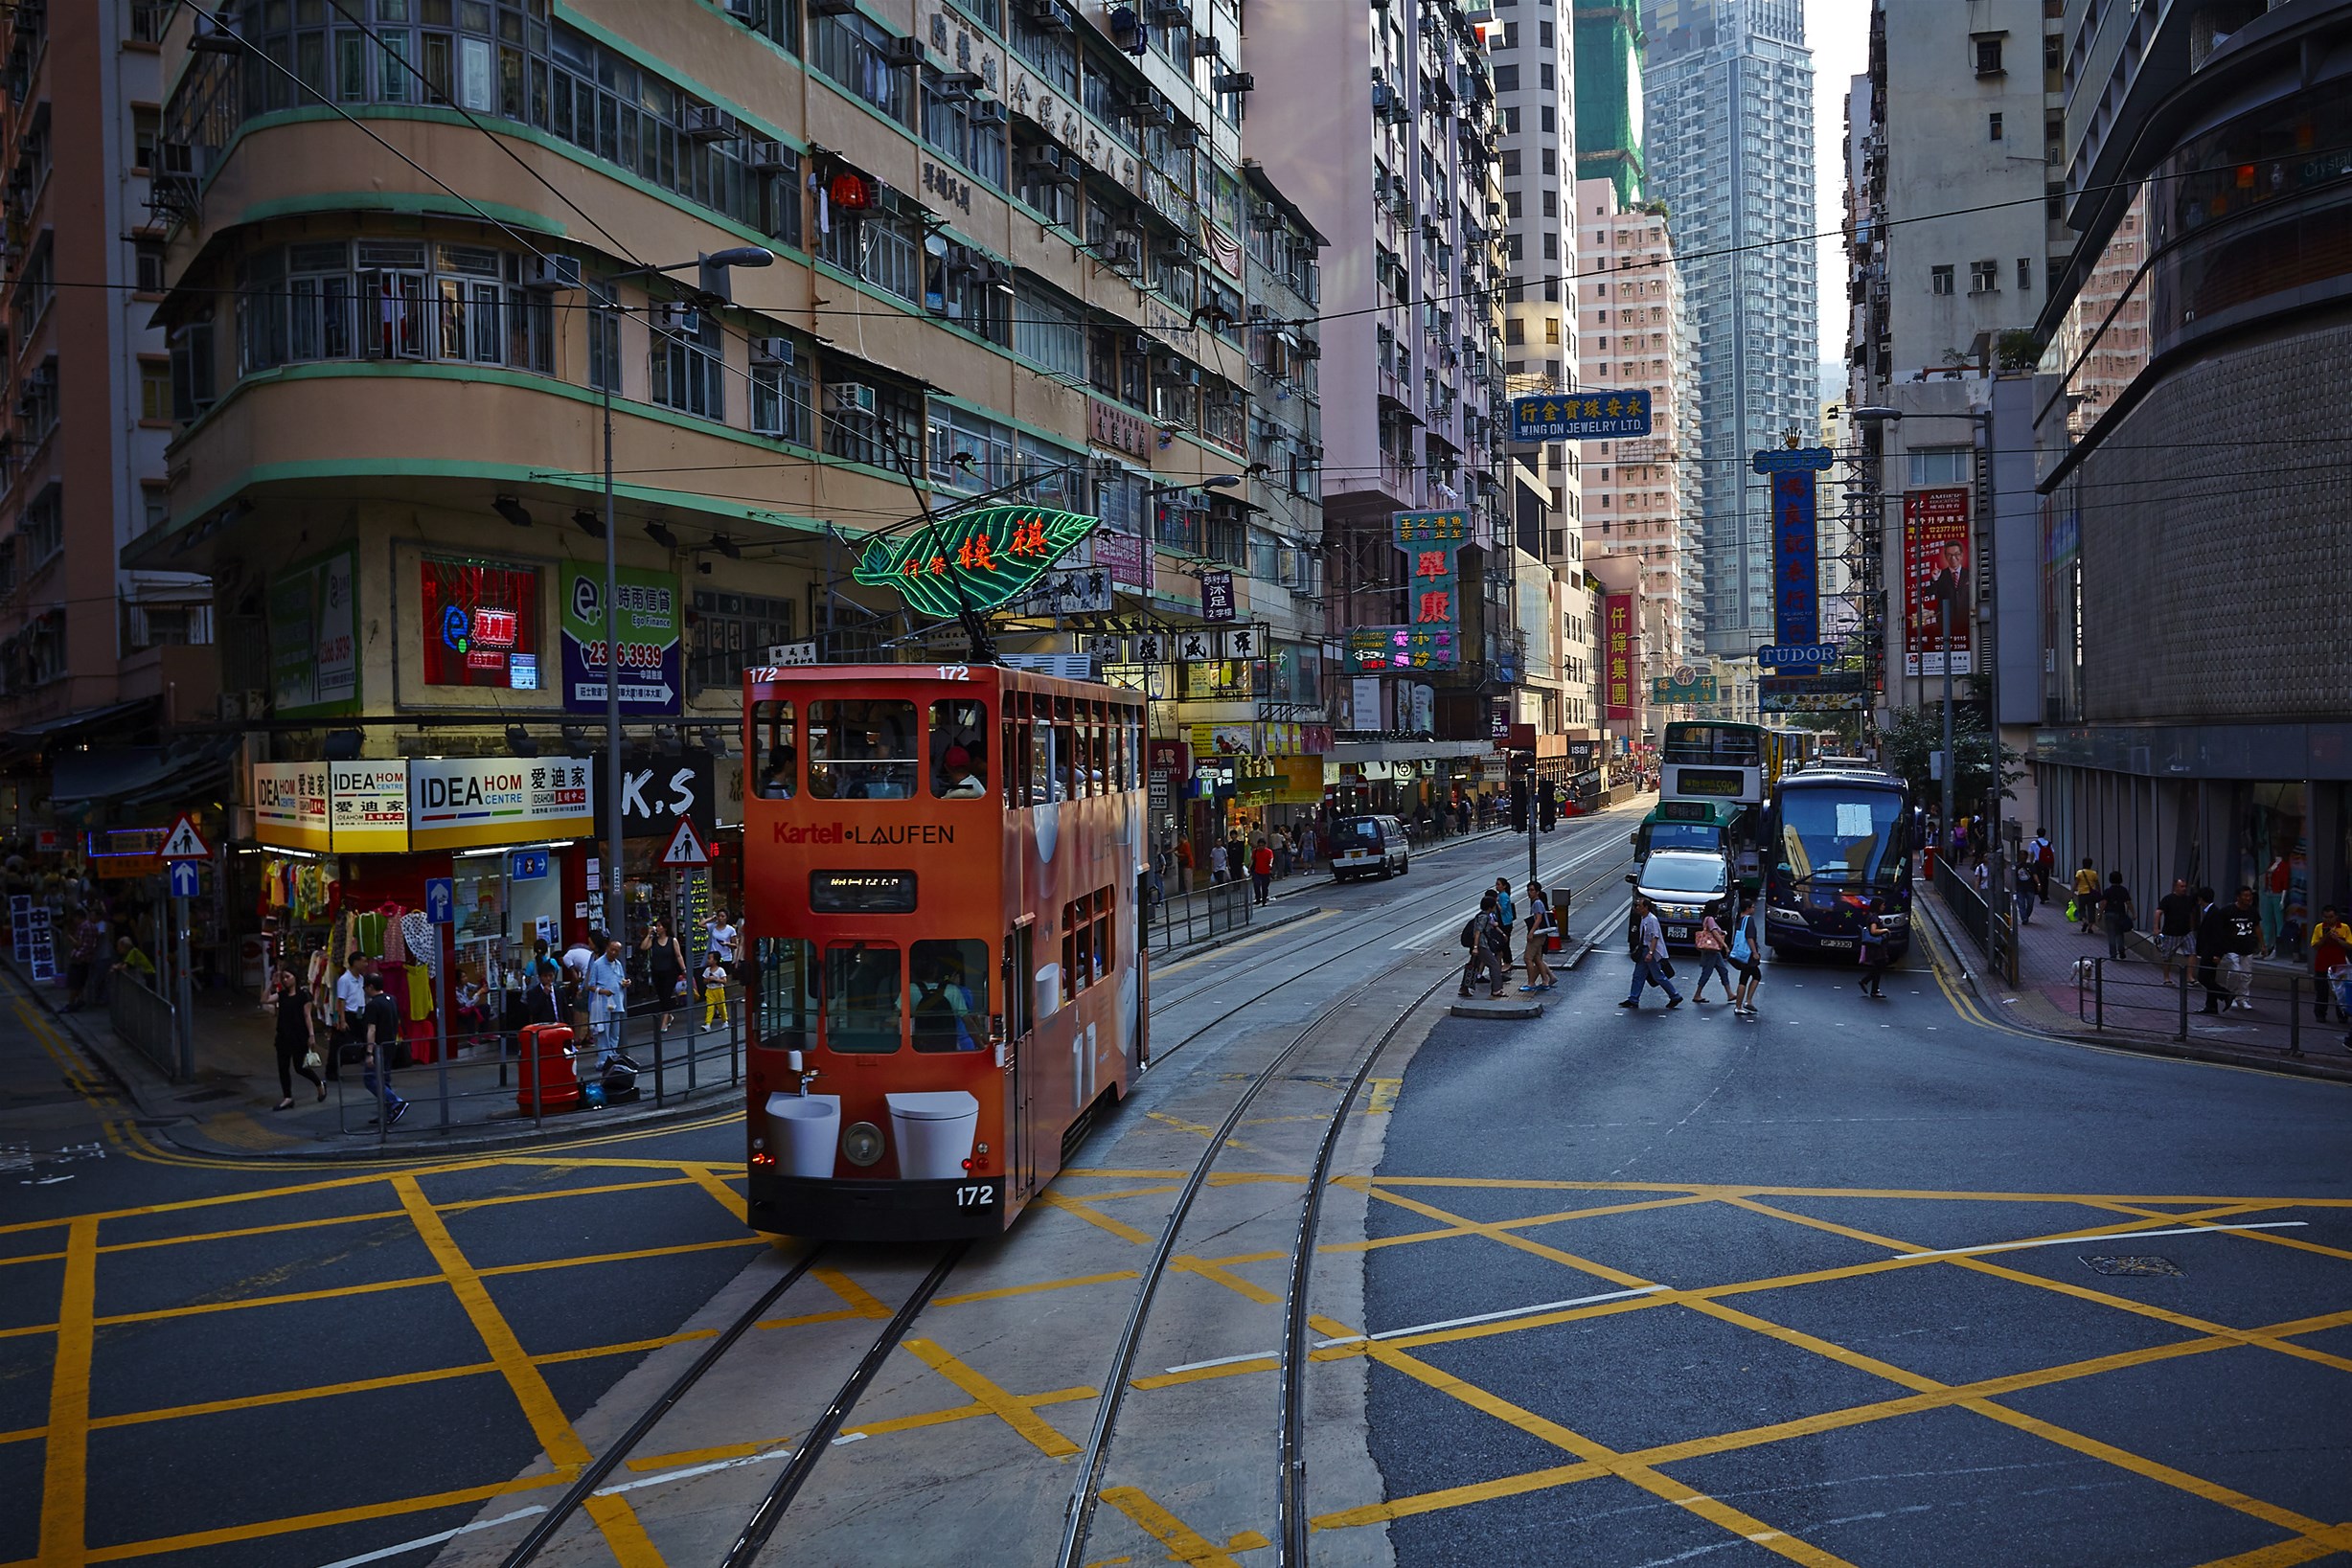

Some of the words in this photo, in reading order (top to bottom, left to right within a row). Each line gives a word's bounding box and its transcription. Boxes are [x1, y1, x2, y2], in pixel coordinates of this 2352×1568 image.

[2304, 151, 2352, 177] Crystal
[1519, 397, 1644, 423] 永安珠寶金行
[1520, 424, 1548, 437] WING
[1550, 422, 1564, 435] ON
[1566, 420, 1617, 434] JEWELRY
[1620, 419, 1644, 431] LTD.
[1757, 451, 1831, 468] ROLEX
[605, 582, 671, 614] 時雨信貸
[1209, 584, 1227, 608] 沐足
[632, 615, 645, 628] Ego
[646, 616, 671, 628] Finance
[589, 641, 625, 667] 236
[628, 644, 663, 669] 3939
[1610, 606, 1628, 706] 仟輝集團
[1761, 647, 1836, 664] TUDOR
[750, 667, 779, 683] 172
[937, 665, 970, 681] 172
[298, 773, 326, 796] 愛迪家
[333, 773, 376, 790] IDEA
[377, 773, 403, 783] HOM
[531, 765, 585, 789] 愛迪家
[258, 778, 281, 807] IDEA
[280, 779, 296, 795] HOM
[421, 776, 484, 809] IDEA
[484, 774, 522, 791] HOM
[485, 793, 522, 806] CENTRE
[334, 801, 404, 813] 愛迪家
[773, 822, 843, 845] Kartell
[856, 826, 954, 845] LAUFEN
[957, 1186, 993, 1206] 172
